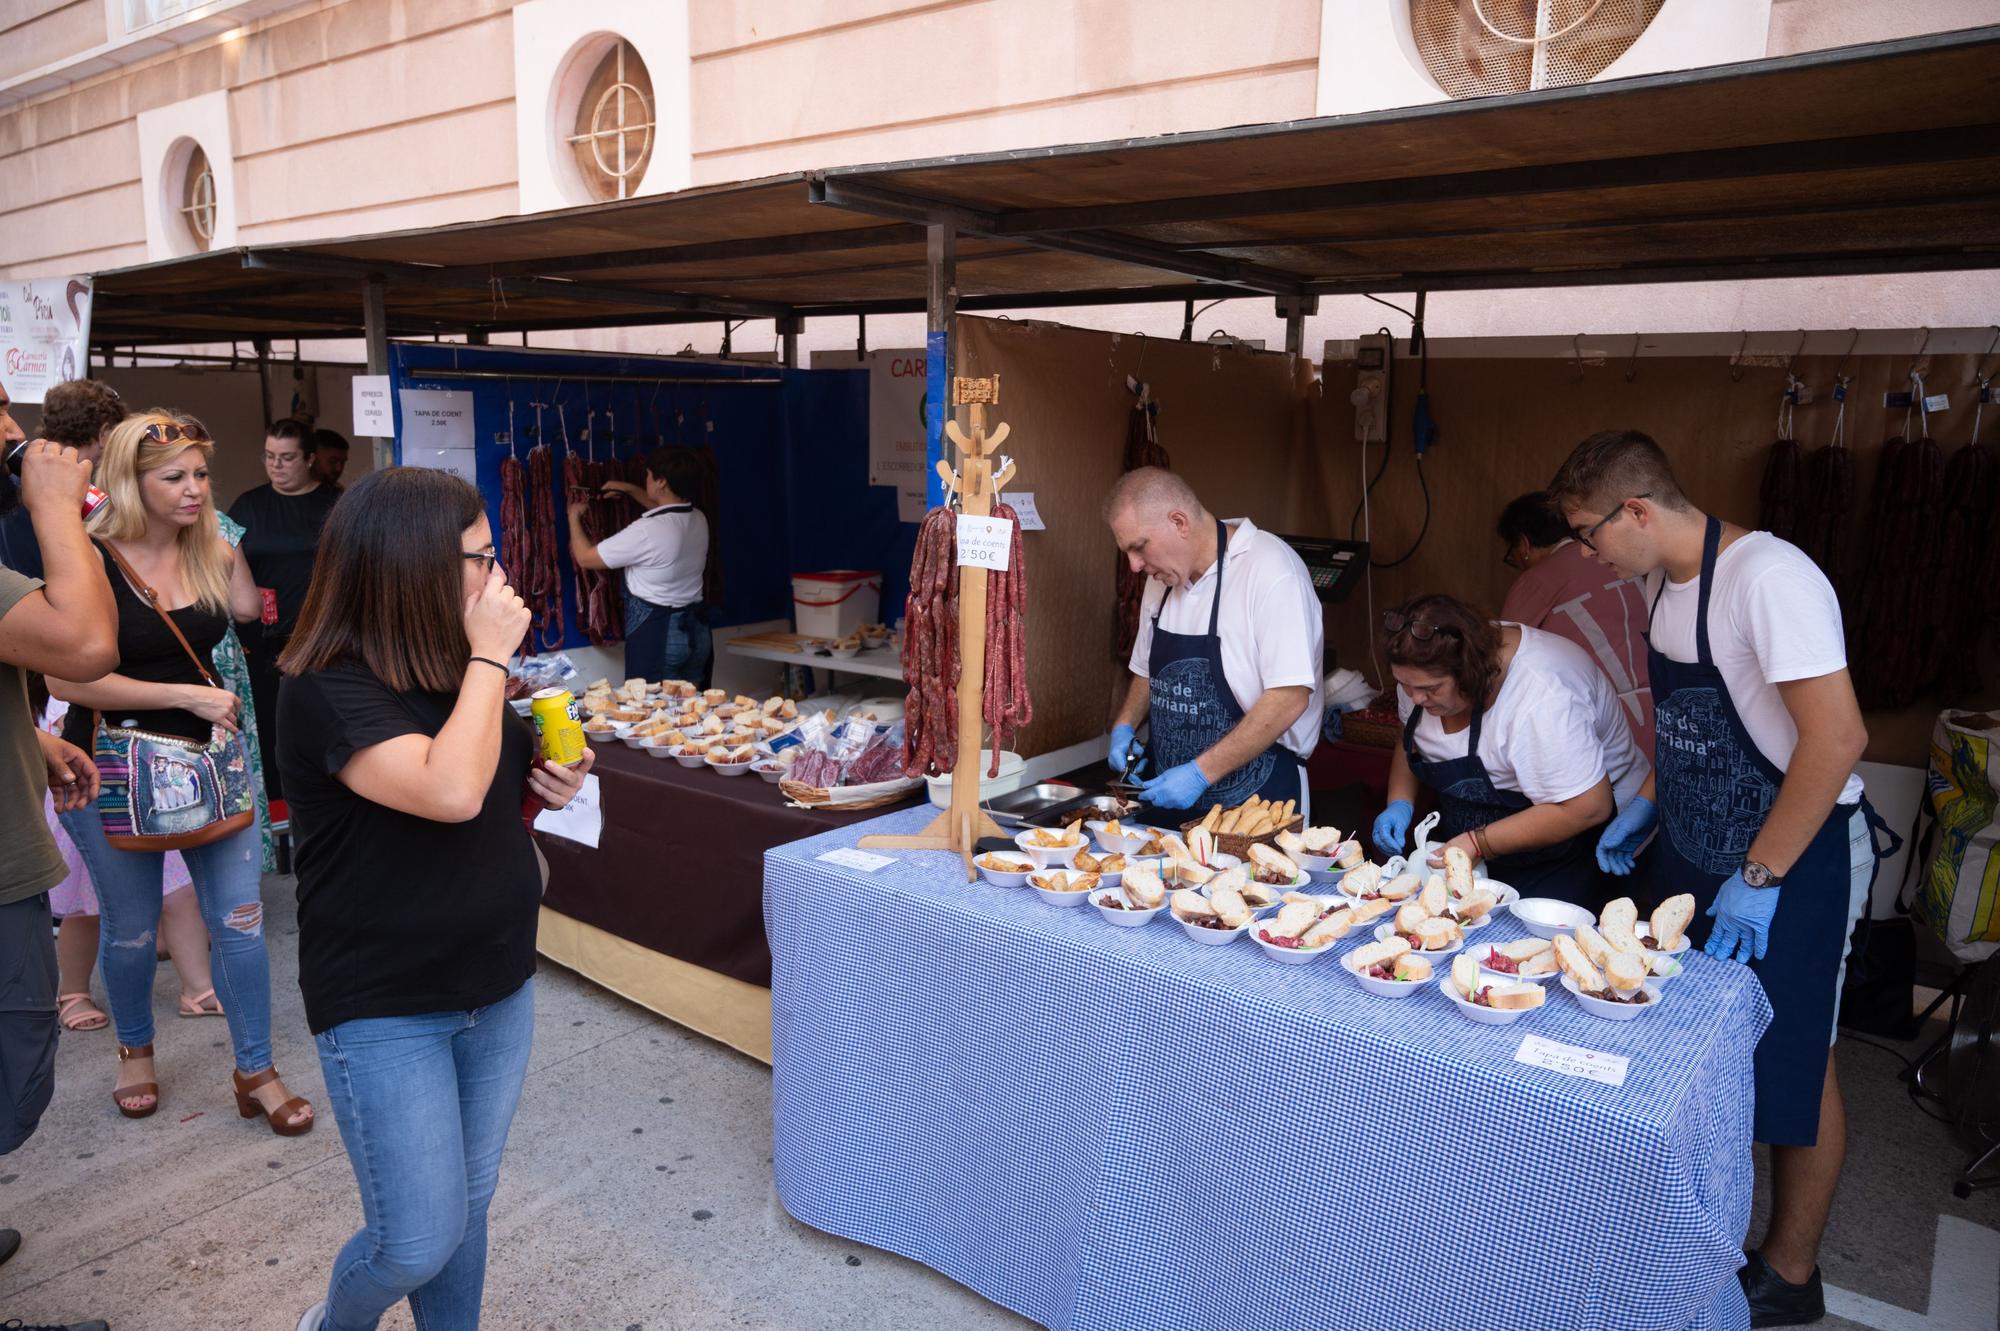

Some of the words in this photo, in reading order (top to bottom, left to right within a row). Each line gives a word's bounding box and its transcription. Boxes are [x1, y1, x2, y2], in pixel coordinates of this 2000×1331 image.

[16, 357, 47, 372] Carmen
[971, 536, 981, 546] de
[983, 540, 1006, 549] coents
[1173, 683, 1192, 698] de
[1677, 715, 1699, 733] de
[1534, 1048, 1560, 1060] Tapa
[1562, 1055, 1577, 1063] de
[1579, 1060, 1616, 1073] coents
